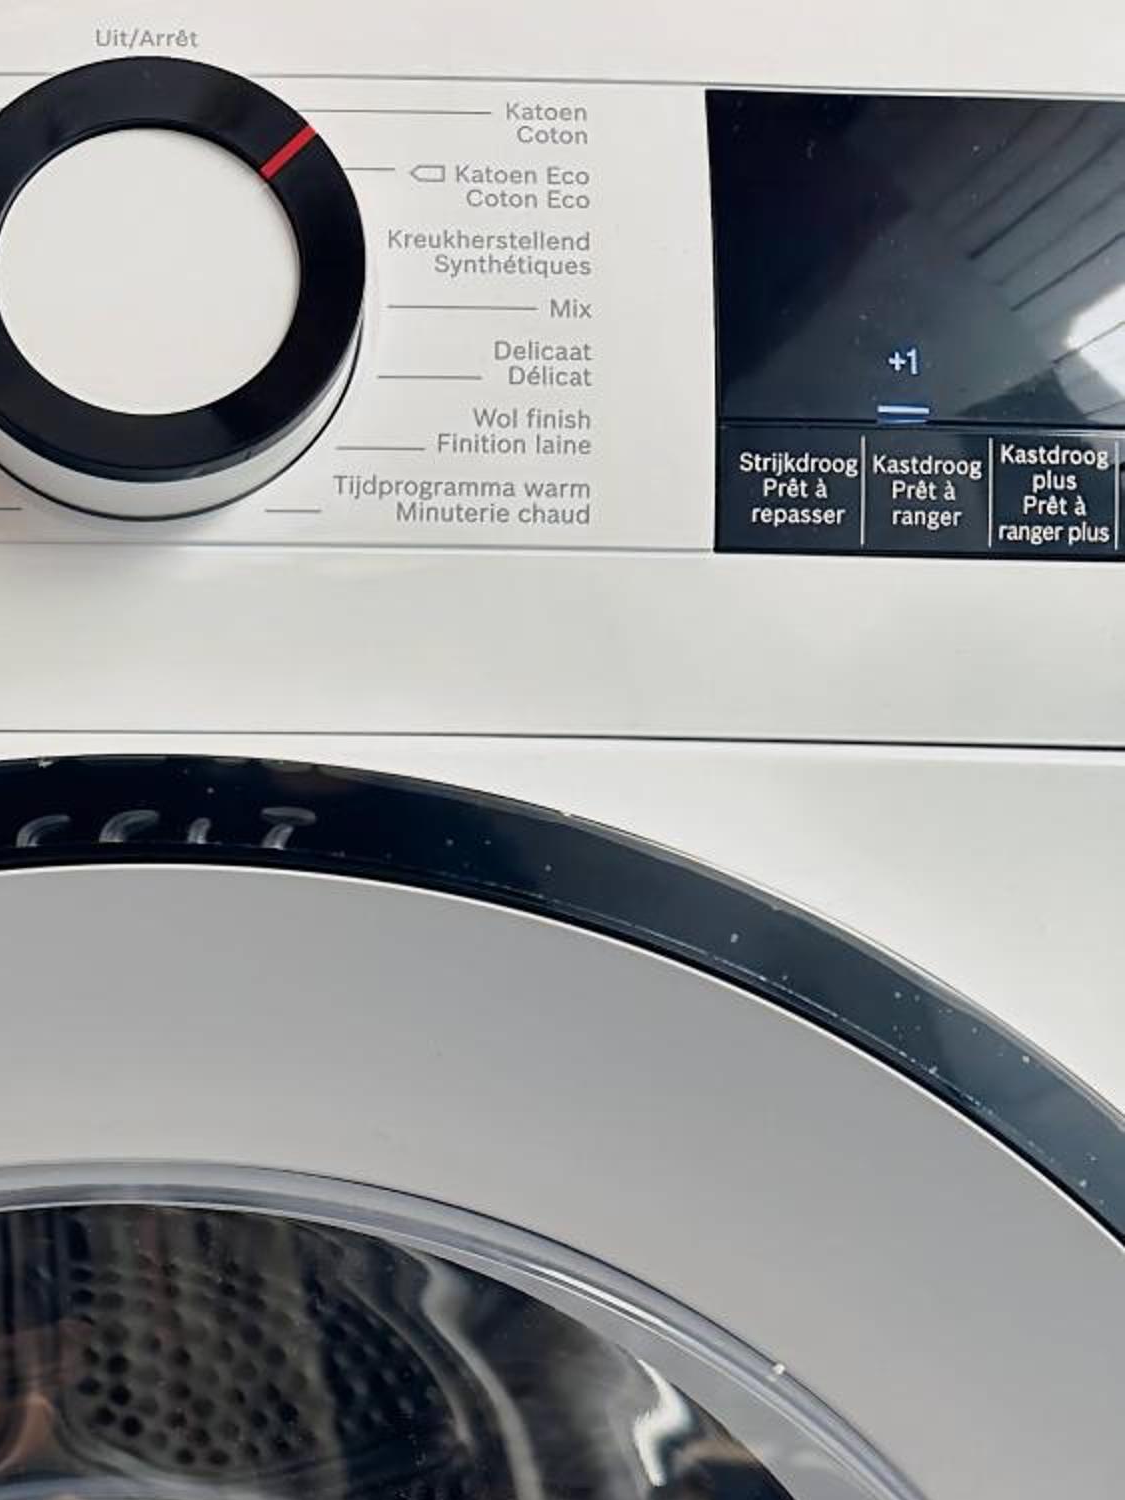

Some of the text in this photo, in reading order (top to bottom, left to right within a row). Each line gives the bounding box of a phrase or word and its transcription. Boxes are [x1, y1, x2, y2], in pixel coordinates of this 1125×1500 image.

[94, 27, 199, 50] Uit/Arrêt
[505, 102, 588, 122] Katoen
[516, 125, 589, 145] Coton
[455, 165, 590, 186] Katoen Eco
[465, 189, 591, 209] Coton Eco
[387, 230, 591, 252] Kreukherstellend
[433, 254, 592, 278] Synthétiques
[549, 299, 592, 319] Mix
[493, 340, 593, 361] Delicaat
[887, 347, 920, 375] +1
[507, 365, 593, 387] Délicat
[472, 407, 592, 430] Wol finish
[437, 433, 592, 455] Finition laine
[739, 451, 859, 477] Strijkdroog
[1000, 443, 1110, 470] Kastdroog
[872, 455, 983, 481] Kastdroog
[333, 475, 591, 500] Tijdprogramma warm
[762, 478, 828, 498] Prêt à
[892, 480, 956, 501] Prêt à
[1032, 471, 1077, 493] plus
[395, 502, 591, 525] Minuterie chaud
[751, 505, 846, 527] repasser
[1022, 495, 1087, 517] Prêt à
[892, 507, 962, 530] ranger
[998, 523, 1110, 545] ranger plus
